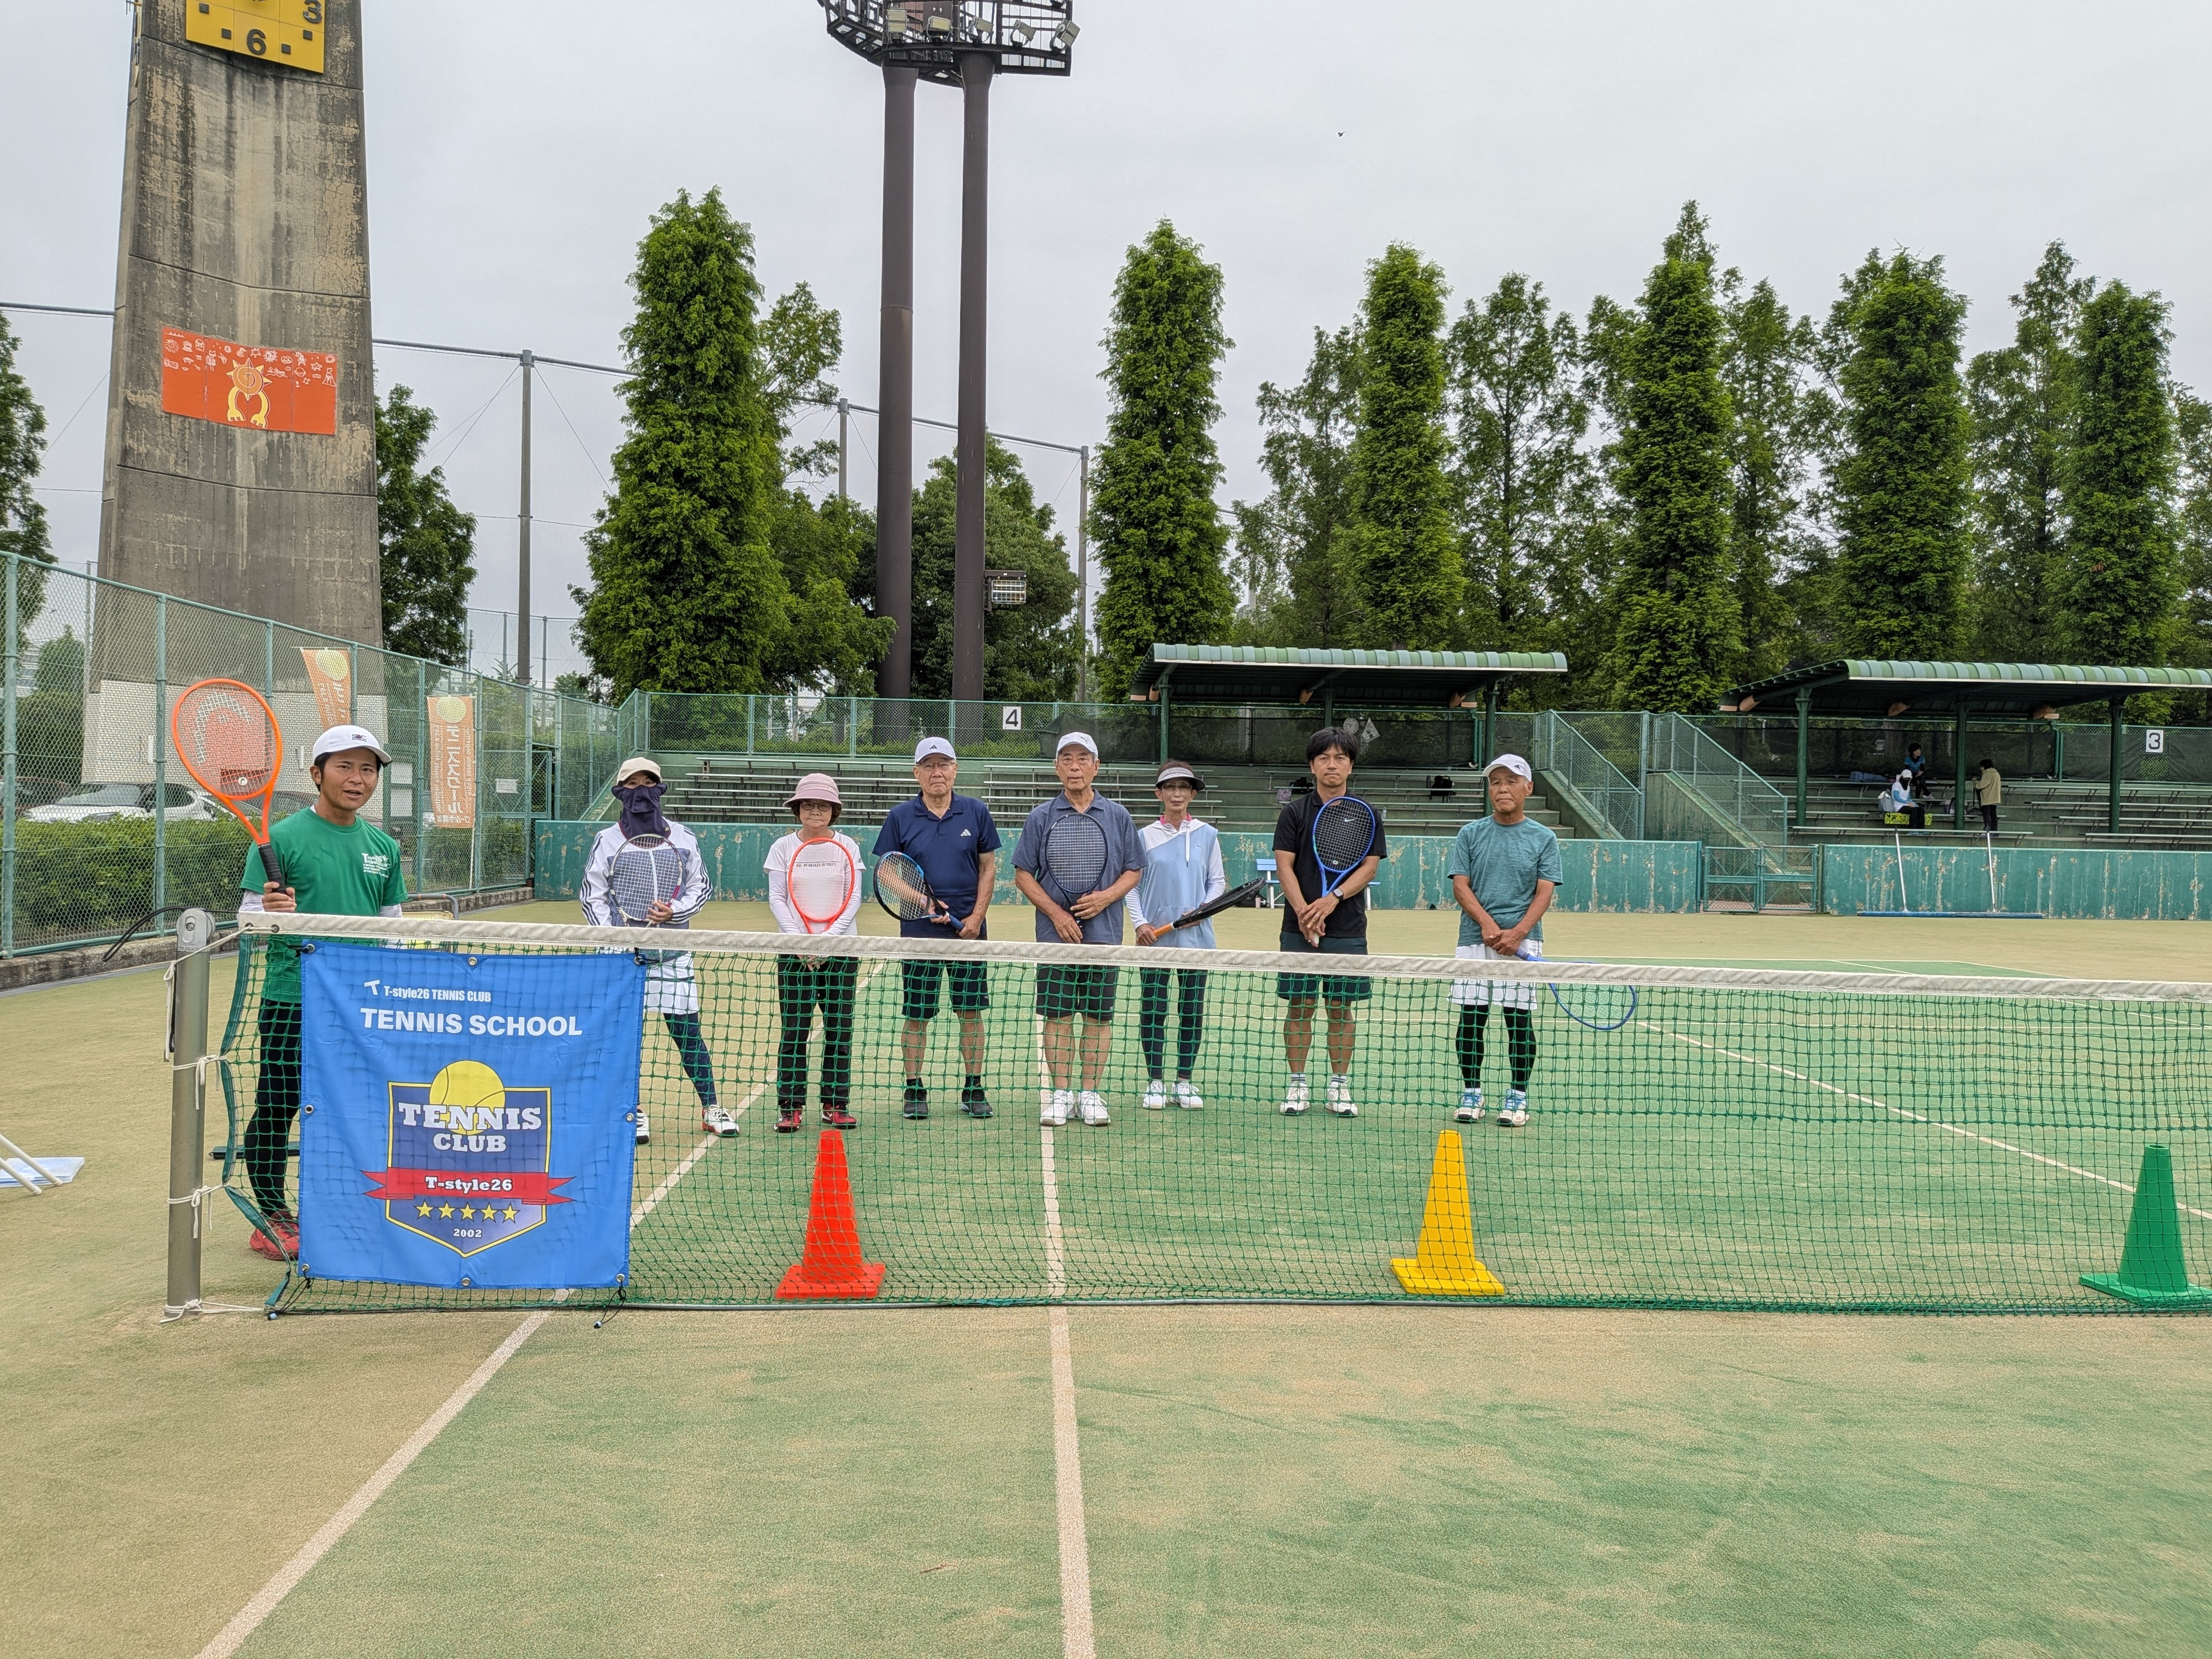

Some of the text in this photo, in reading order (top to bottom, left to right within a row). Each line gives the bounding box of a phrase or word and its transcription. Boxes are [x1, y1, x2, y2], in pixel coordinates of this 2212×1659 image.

[303, 0, 322, 23] 3
[247, 29, 267, 55] 6
[1005, 709, 1019, 727] 4
[2148, 732, 2161, 750] 3
[384, 985, 492, 1003] T-style26 TENNIS CLUB
[360, 1008, 582, 1036] TENNIS SCHOOL
[398, 1102, 542, 1131] TENNIS
[433, 1133, 507, 1152] CLUB
[425, 1176, 513, 1194] T-style26
[453, 1228, 483, 1238] 2002
